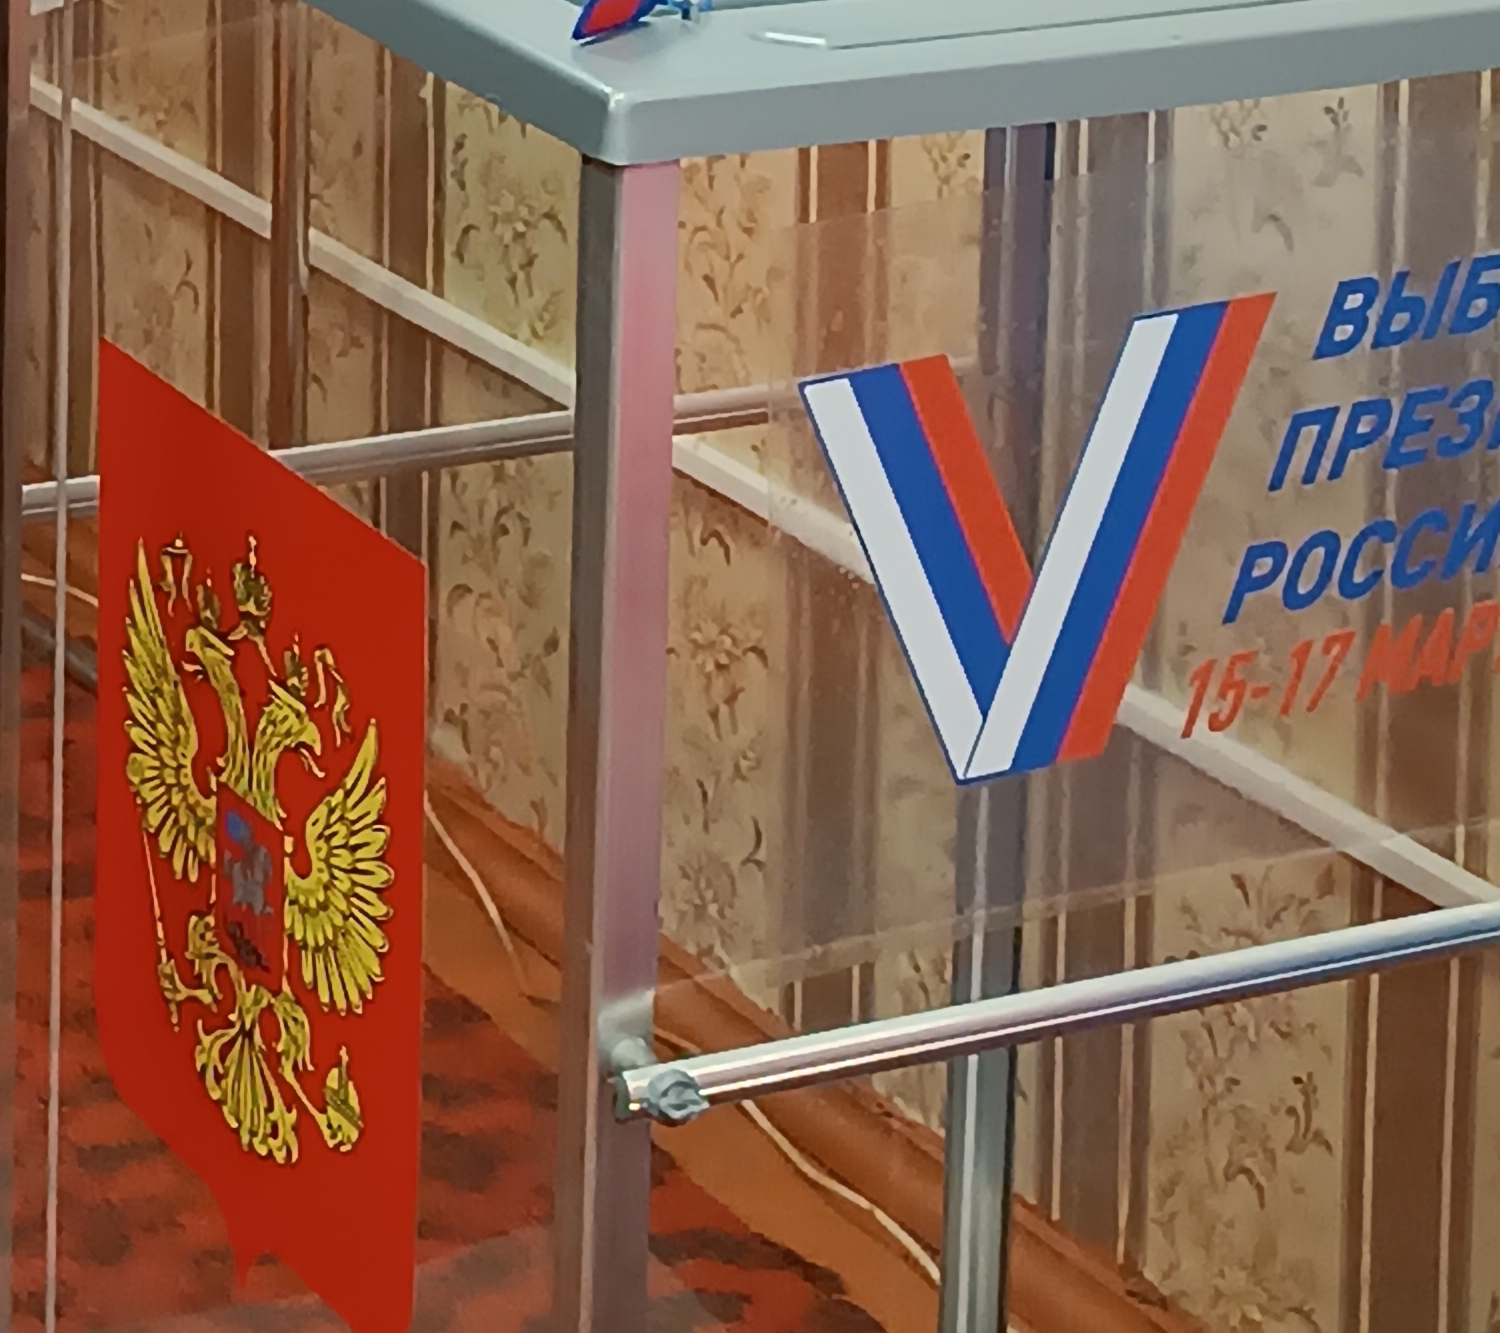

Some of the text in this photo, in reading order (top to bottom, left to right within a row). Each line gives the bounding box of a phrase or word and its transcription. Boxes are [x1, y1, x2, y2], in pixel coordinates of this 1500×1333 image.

[1311, 253, 1500, 360] ВЫБ
[1267, 378, 1500, 492] ПРЕЗ
[1221, 497, 1500, 626] РОССИ
[1180, 600, 1500, 740] 15-17 МАР
